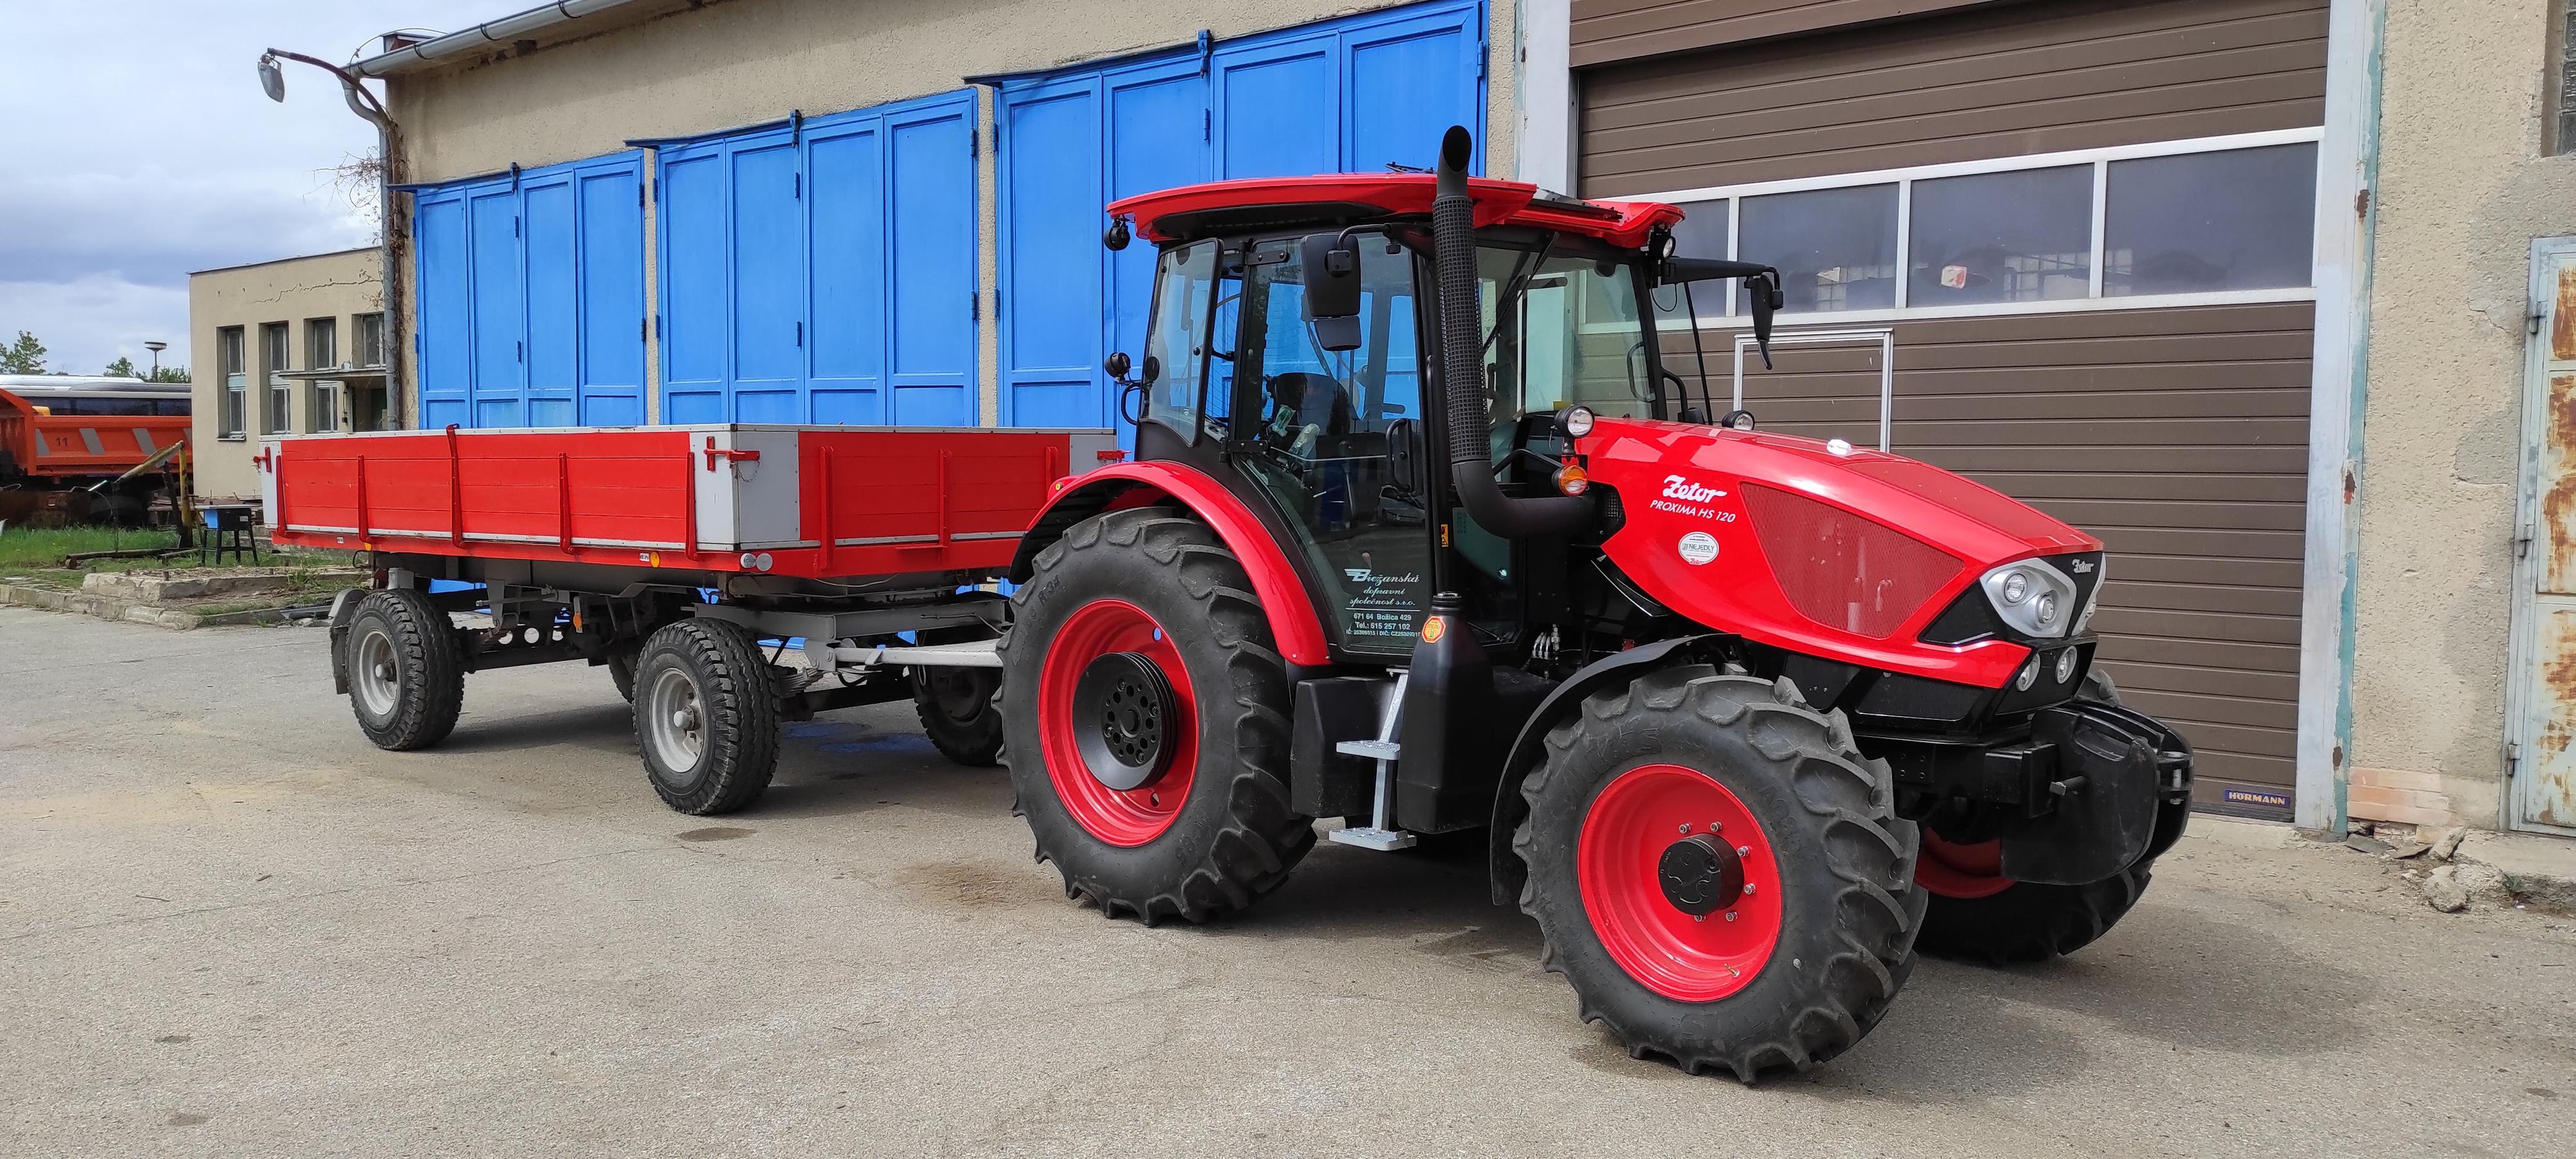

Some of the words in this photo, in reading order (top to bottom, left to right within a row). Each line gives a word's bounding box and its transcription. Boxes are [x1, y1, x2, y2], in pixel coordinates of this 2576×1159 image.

[55, 437, 68, 446] 11
[1663, 475, 1727, 503] Zetor
[1650, 500, 1696, 516] PROXIMA
[1698, 508, 1714, 519] HS
[1716, 511, 1736, 523] 120
[2072, 559, 2094, 573] Zetor
[1363, 586, 1406, 598] dopravní
[1349, 596, 1394, 607] společnost
[1355, 621, 1369, 629] Tel.:
